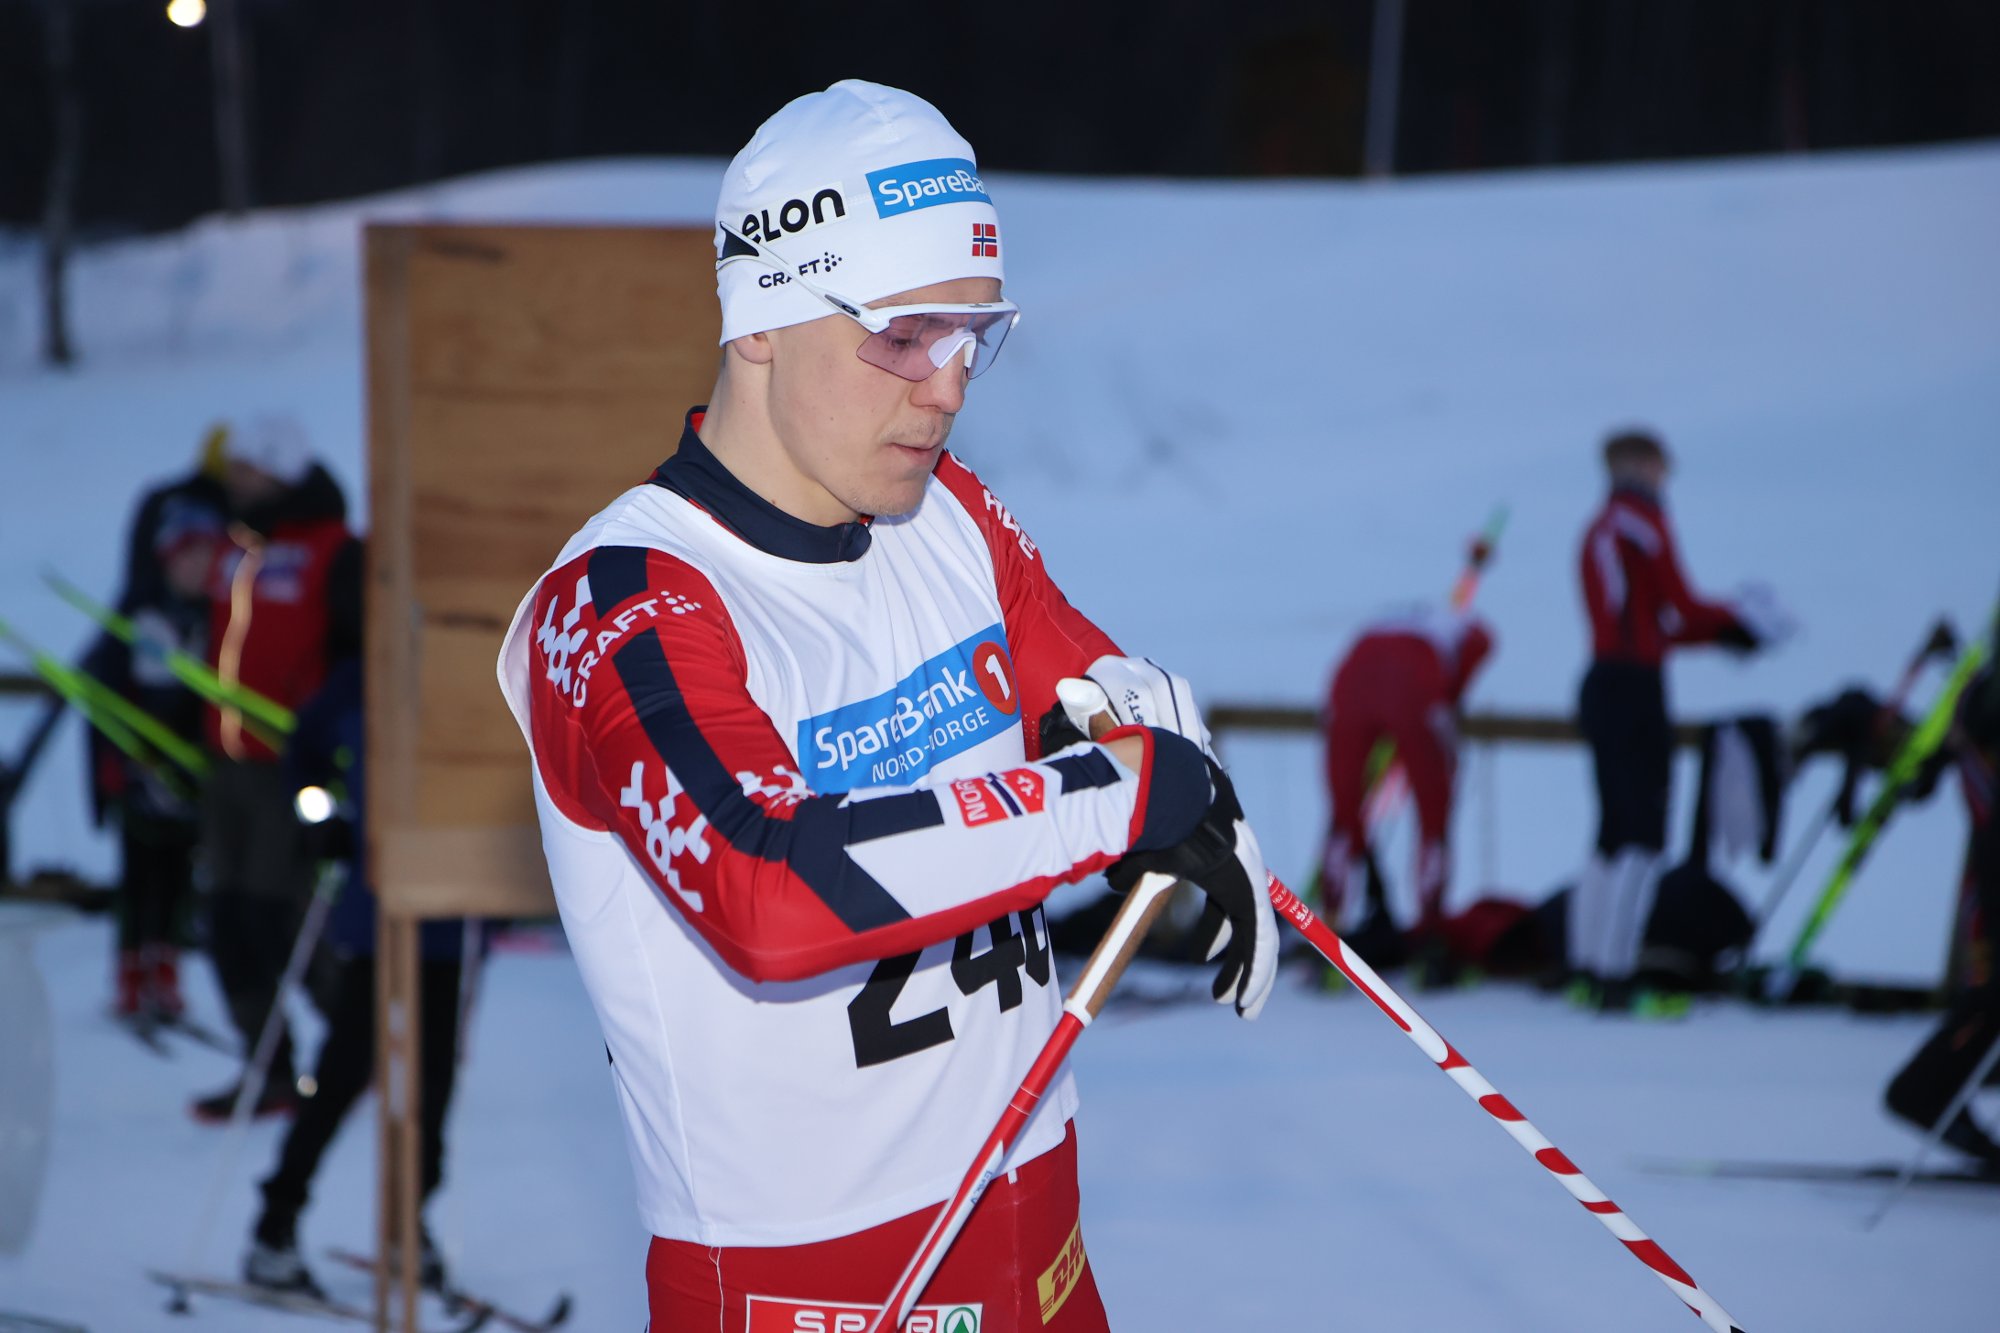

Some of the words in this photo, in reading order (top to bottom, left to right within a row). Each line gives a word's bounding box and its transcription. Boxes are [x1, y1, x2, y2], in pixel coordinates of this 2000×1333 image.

[878, 169, 988, 207] SpareBa
[573, 598, 660, 708] CRAFT
[815, 667, 977, 771] SpareBank
[846, 900, 1050, 1069] 240
[793, 1309, 934, 1333] SPR
